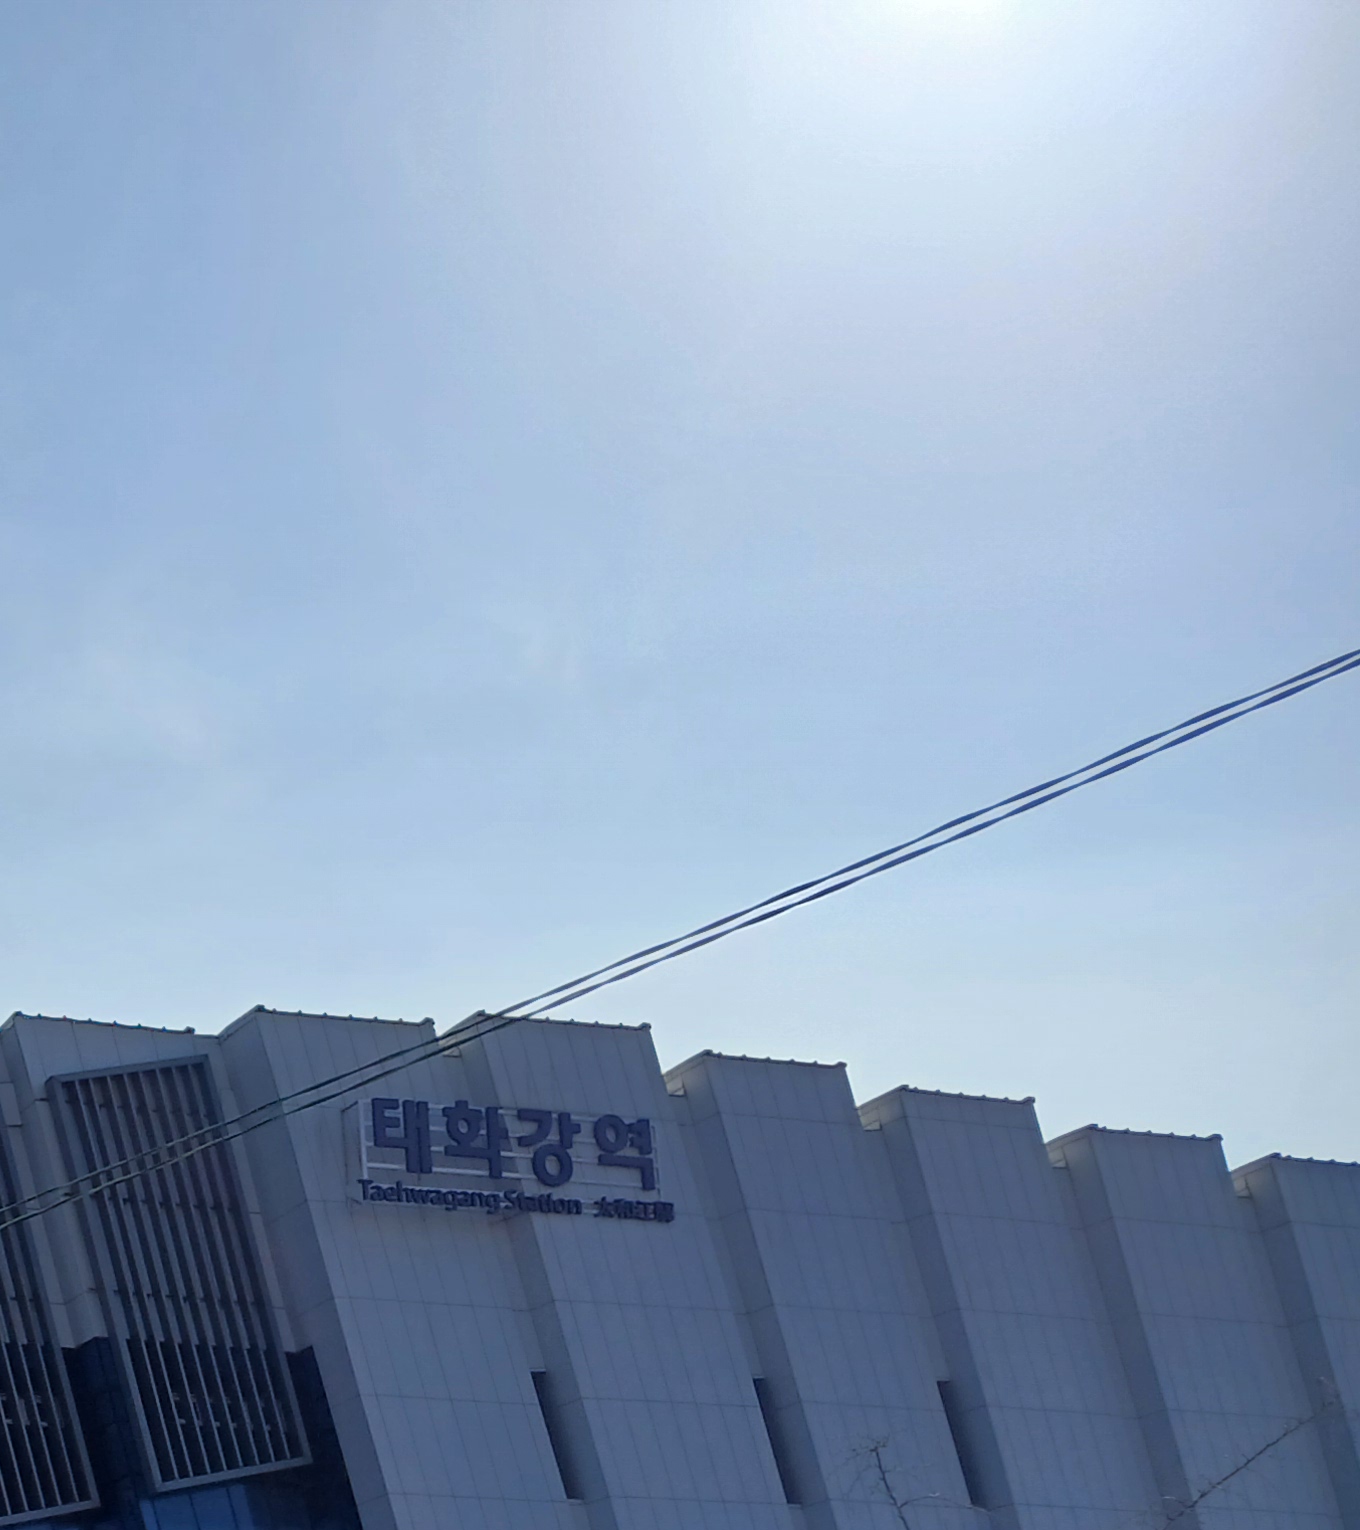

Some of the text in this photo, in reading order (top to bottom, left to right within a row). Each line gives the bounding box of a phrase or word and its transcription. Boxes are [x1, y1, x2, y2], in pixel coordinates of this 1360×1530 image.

[371, 1098, 656, 1191] 태화강역
[356, 1178, 583, 1216] Taehwagang Station
